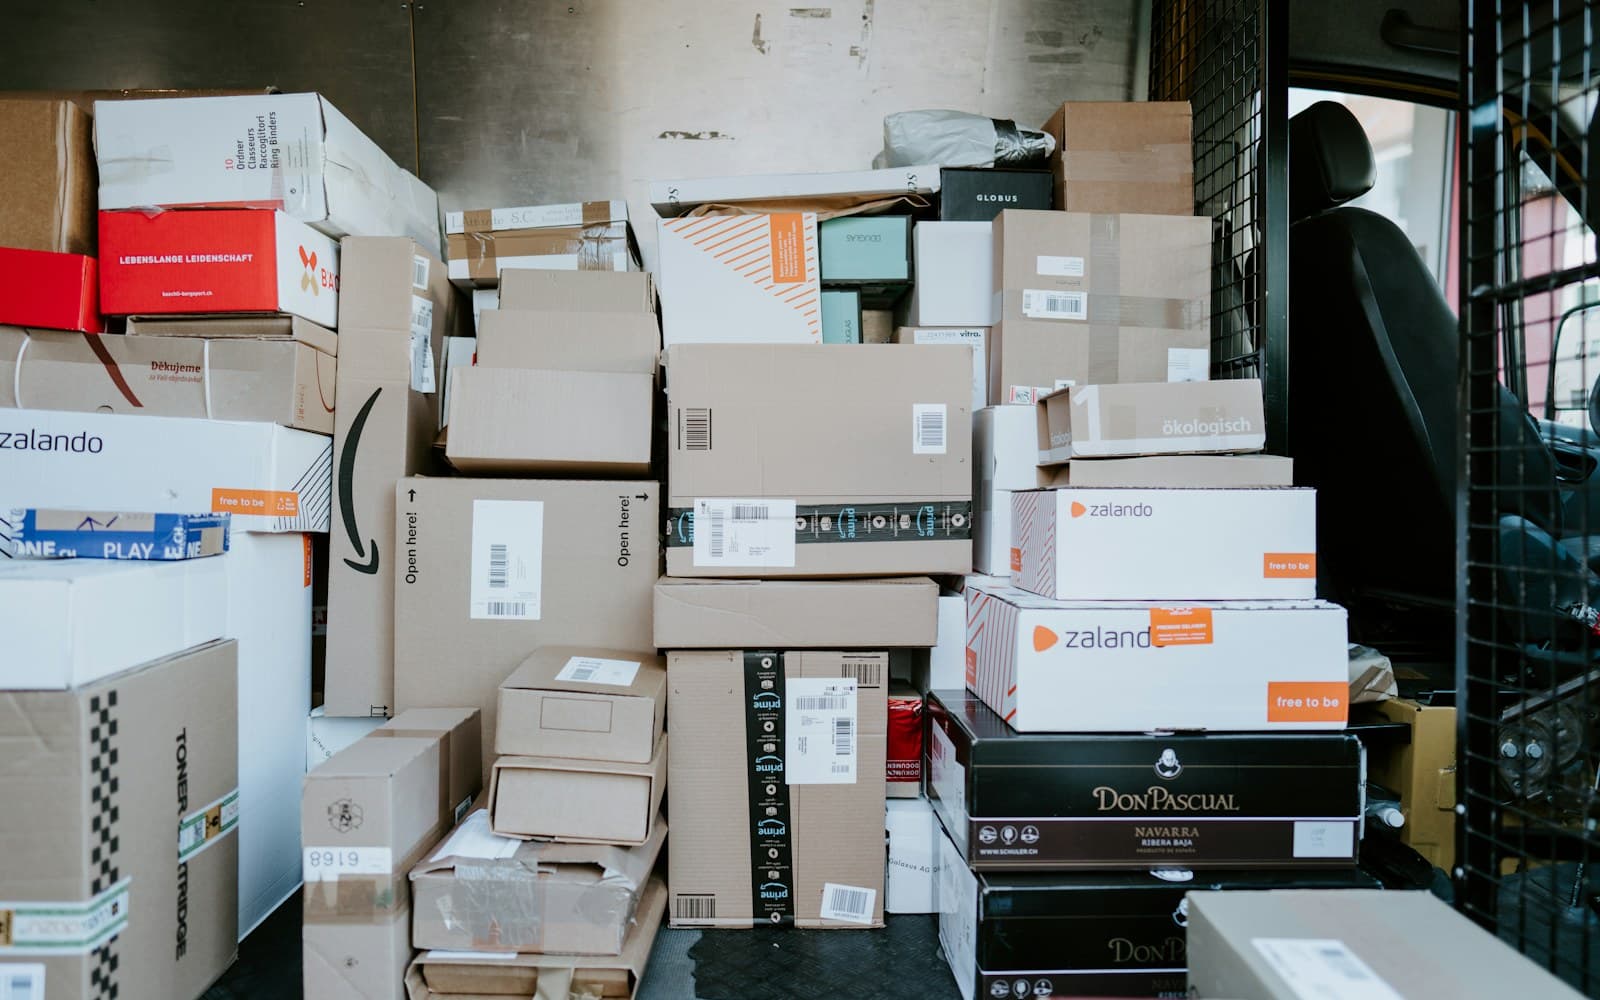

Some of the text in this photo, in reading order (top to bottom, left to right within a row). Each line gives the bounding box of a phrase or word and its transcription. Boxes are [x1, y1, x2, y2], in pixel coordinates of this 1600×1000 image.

[256, 115, 268, 169] Raccoglitori
[267, 111, 281, 169] Ring Binders
[236, 140, 246, 170] Ordner
[247, 128, 257, 170] Classeurs
[224, 158, 235, 170] 10
[976, 194, 1018, 203] GLOBUS
[846, 234, 882, 243] DOUGLAS
[119, 253, 253, 265] LEBENSLANGE LEIDENSCHAFT
[959, 329, 981, 338] vitra.
[151, 360, 202, 375] Děkujeme
[1162, 417, 1251, 435] ökologisch
[0, 428, 104, 454] zalando
[220, 496, 265, 507] free to be
[1090, 501, 1153, 517] zalando
[846, 508, 856, 539] prime
[926, 505, 935, 537] prime
[617, 495, 631, 567] Open here!
[103, 541, 154, 560] PLAY
[405, 512, 419, 584] Open here!
[1269, 562, 1287, 570] free
[1299, 562, 1310, 570] be
[1065, 624, 1166, 649] zaland
[753, 700, 781, 711] prime
[1276, 695, 1339, 708] free to be
[175, 727, 189, 816] TONER
[755, 763, 783, 773] prime
[758, 826, 786, 837] prime
[1135, 826, 1200, 838] NAVARRA
[1141, 838, 1193, 848] RIBERA BAJA
[310, 851, 359, 867] 6168
[760, 890, 789, 901] prime
